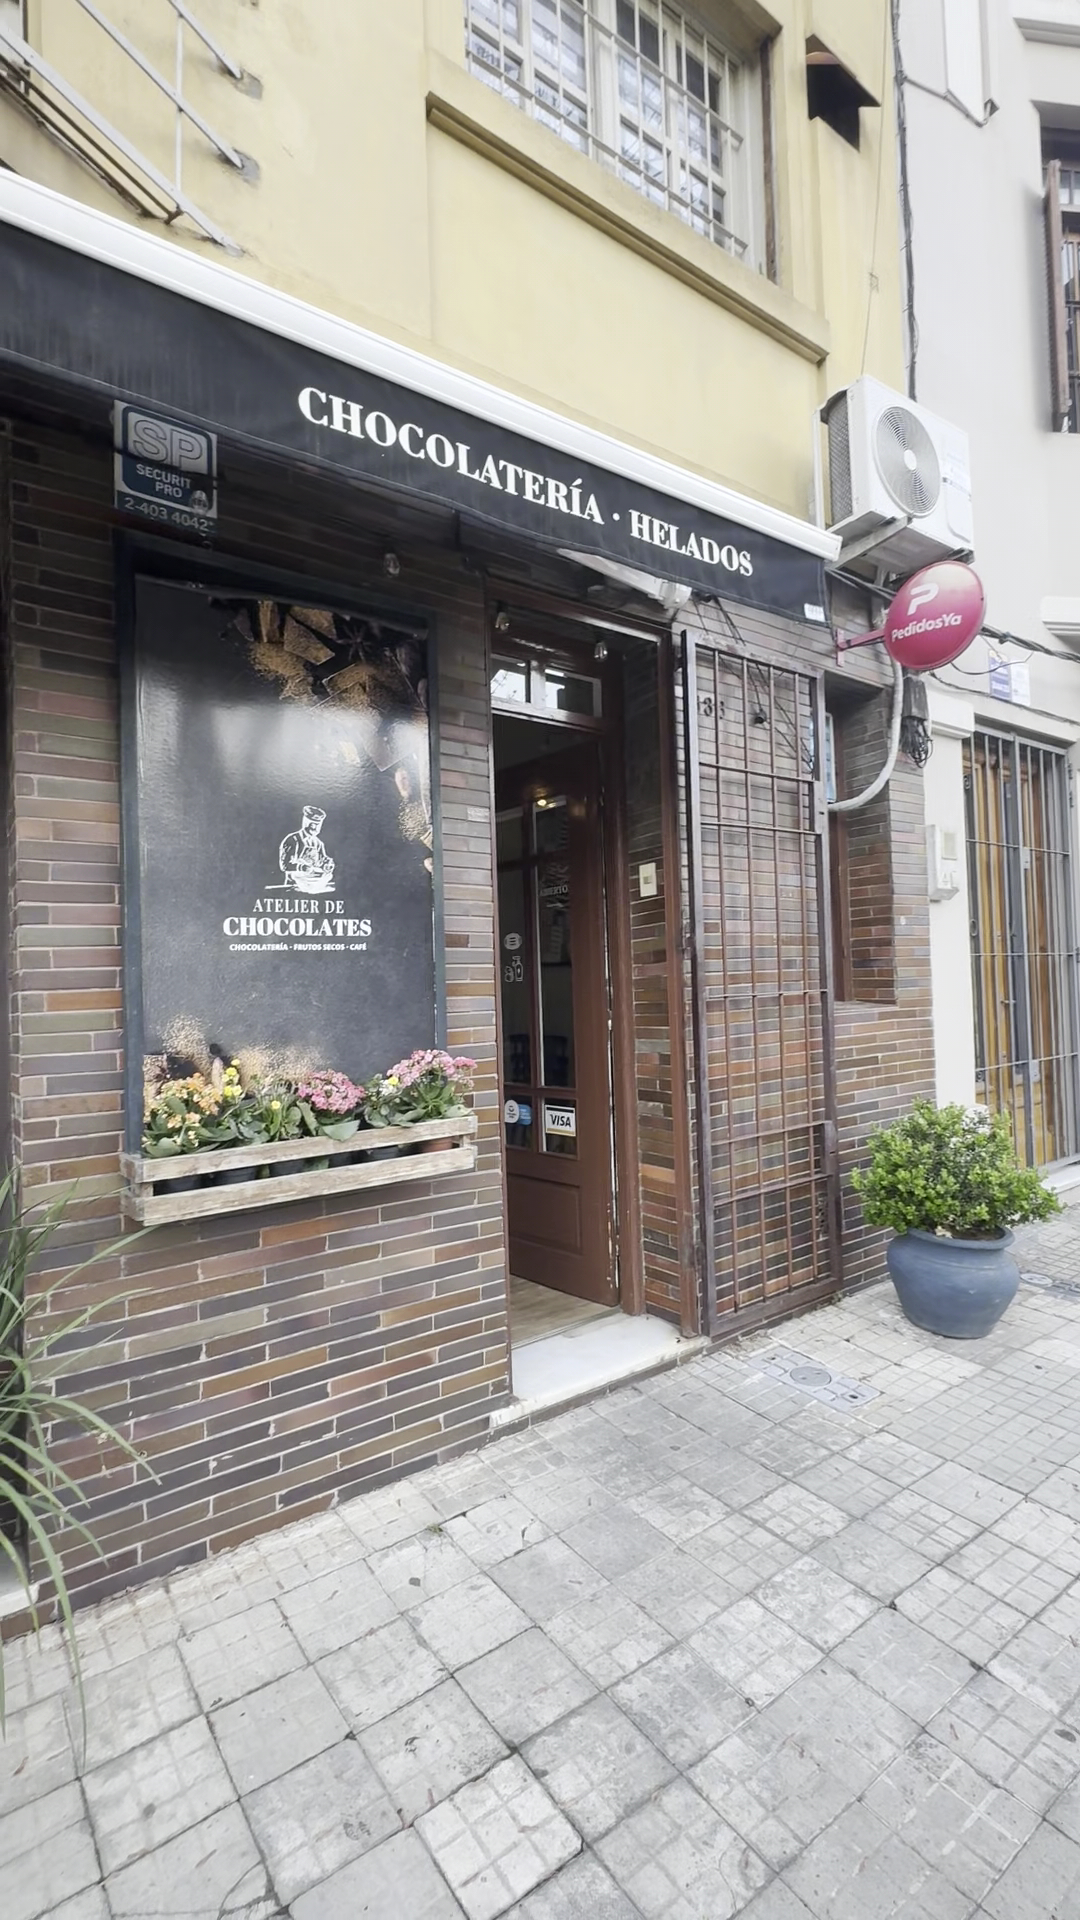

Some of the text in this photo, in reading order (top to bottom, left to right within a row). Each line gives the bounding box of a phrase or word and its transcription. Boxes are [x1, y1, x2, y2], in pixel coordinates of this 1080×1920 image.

[133, 419, 203, 468] SP
[155, 481, 183, 498] PRO
[298, 386, 754, 577] CHOCOLATERÍA HELADOS
[891, 612, 962, 643] PedidosYa
[252, 898, 345, 914] ATELIER DE
[222, 916, 373, 937] CHOCOLATES
[229, 942, 367, 951] CHOCOLATERÍA FRUTOS SECOS CAFÉ
[549, 1113, 572, 1128] VISA
